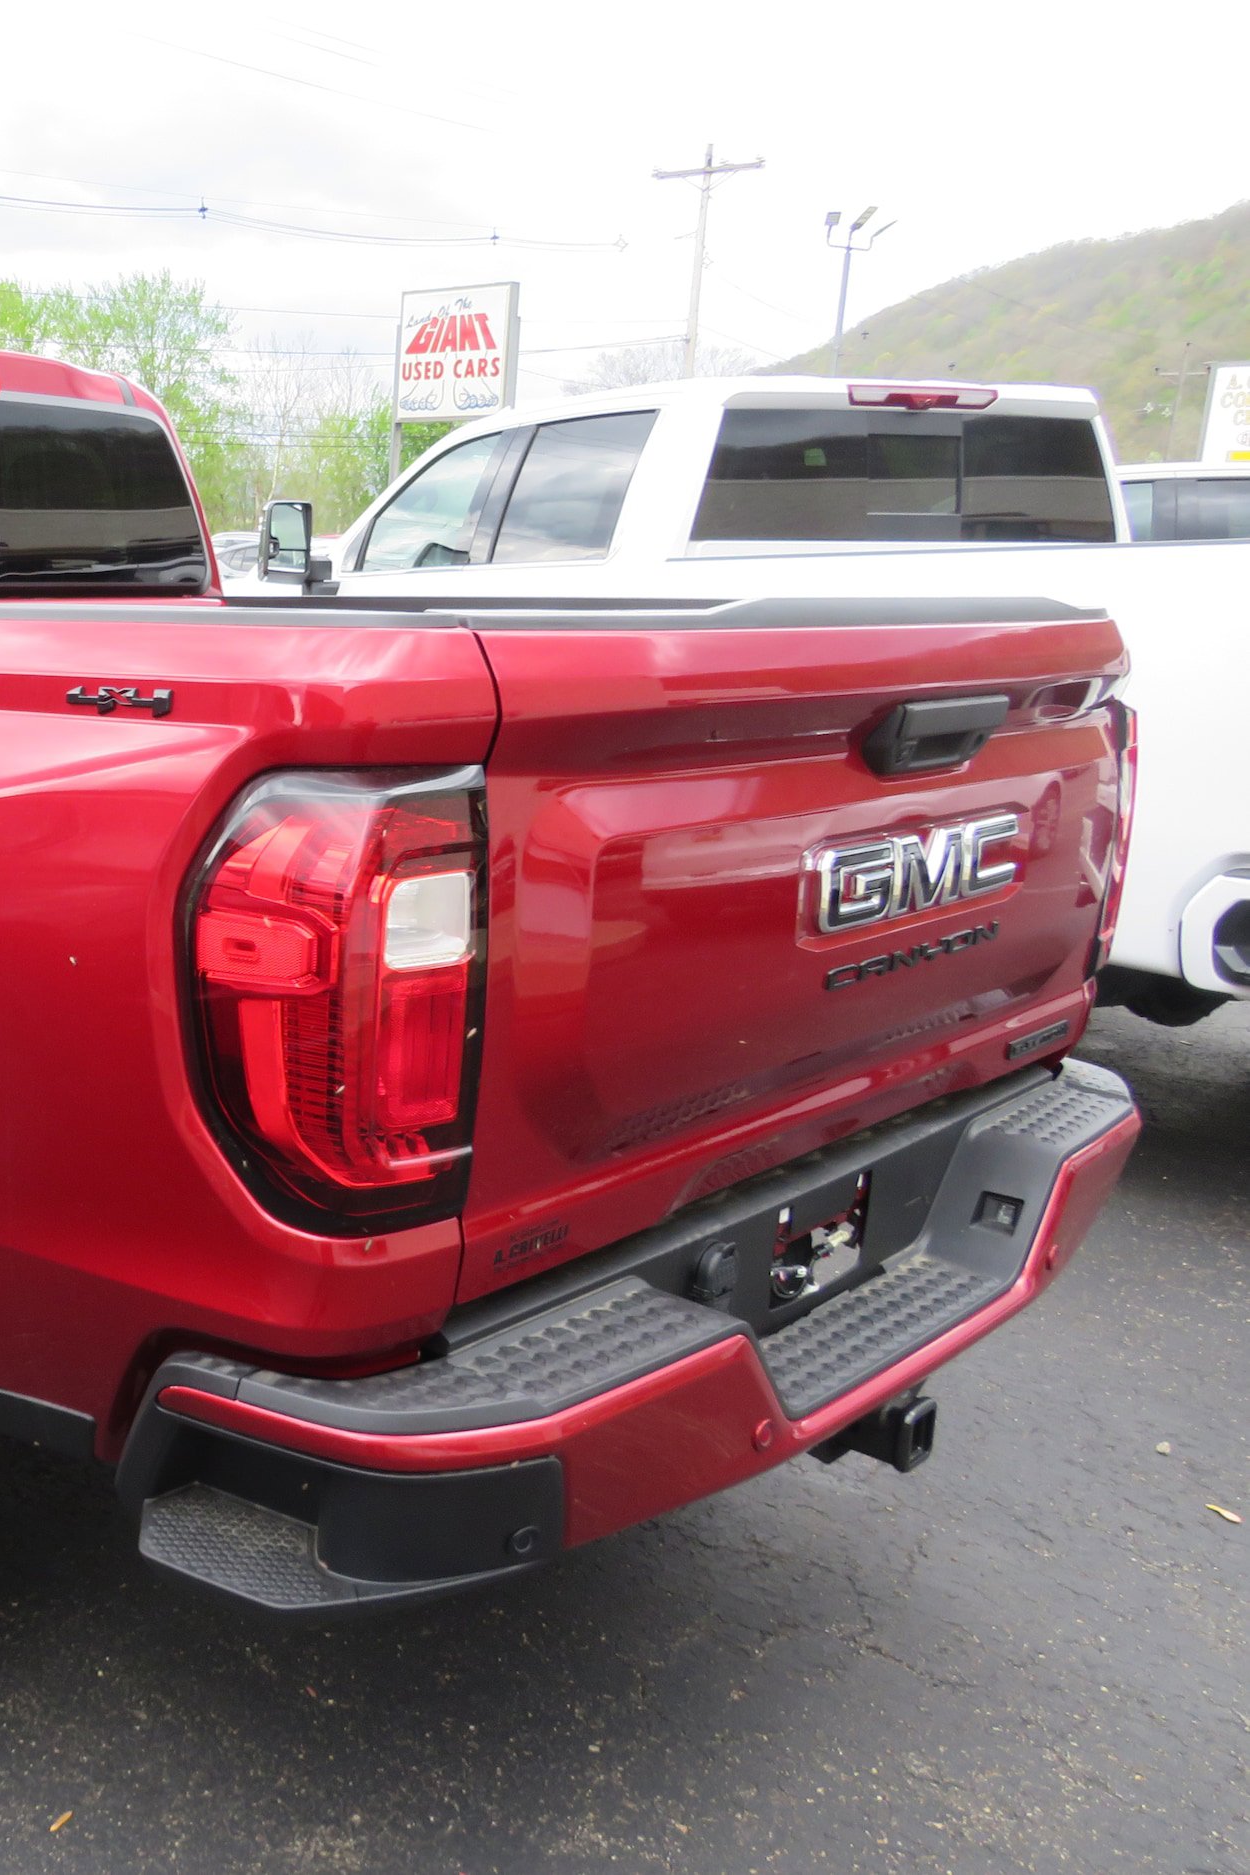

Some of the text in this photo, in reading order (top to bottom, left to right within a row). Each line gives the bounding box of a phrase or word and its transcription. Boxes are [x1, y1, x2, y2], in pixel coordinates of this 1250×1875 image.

[406, 311, 432, 328] Land
[455, 297, 472, 311] The
[405, 313, 497, 355] GIANT
[402, 357, 500, 382] USED CARS
[818, 813, 1020, 933] GMC
[824, 920, 999, 992] CANYON
